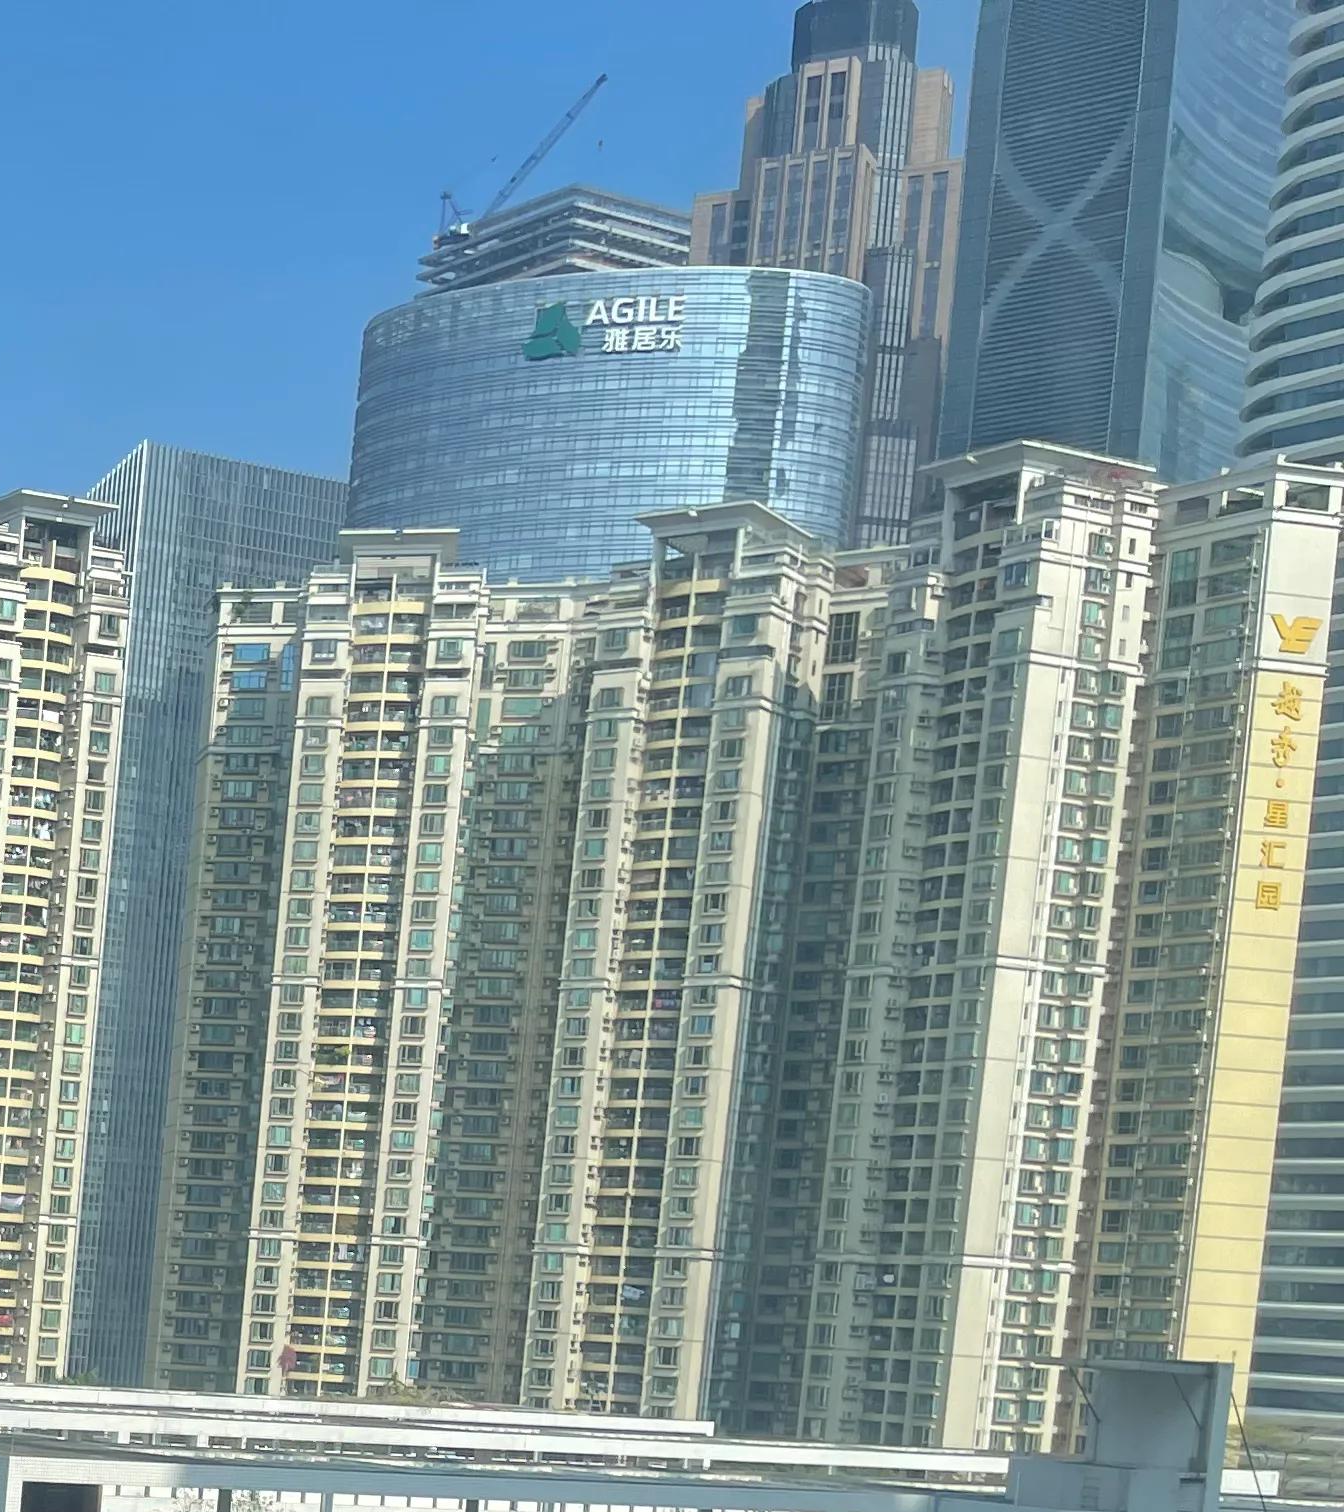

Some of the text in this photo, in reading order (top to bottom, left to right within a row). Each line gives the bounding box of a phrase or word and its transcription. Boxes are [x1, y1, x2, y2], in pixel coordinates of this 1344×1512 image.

[585, 295, 687, 325] AGILE
[601, 326, 684, 353] 雅居乐
